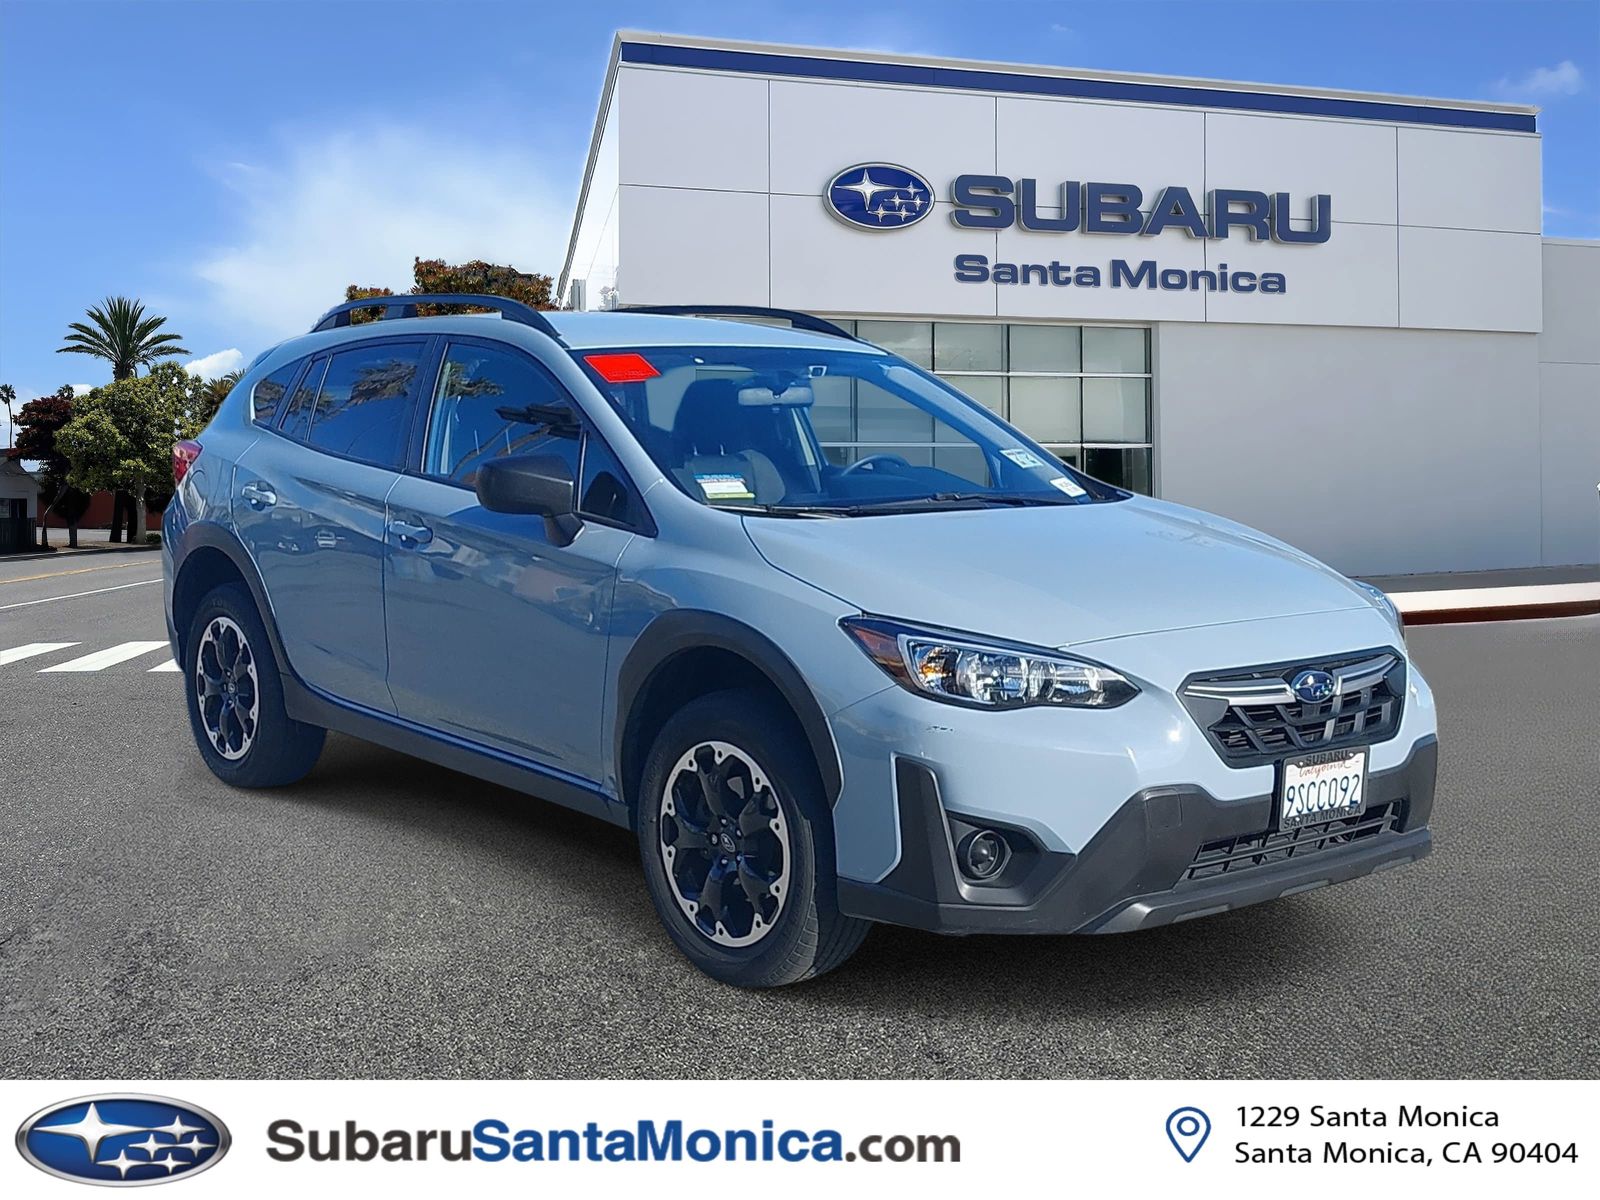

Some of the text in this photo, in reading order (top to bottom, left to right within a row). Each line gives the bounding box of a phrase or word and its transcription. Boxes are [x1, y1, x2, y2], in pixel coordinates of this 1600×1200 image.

[949, 173, 1331, 243] SUBARU
[954, 254, 1287, 294] Santa Monica
[1305, 750, 1348, 765] SUBARU
[1285, 774, 1360, 819] 9SCC092
[1284, 805, 1361, 829] SANTA MONICA
